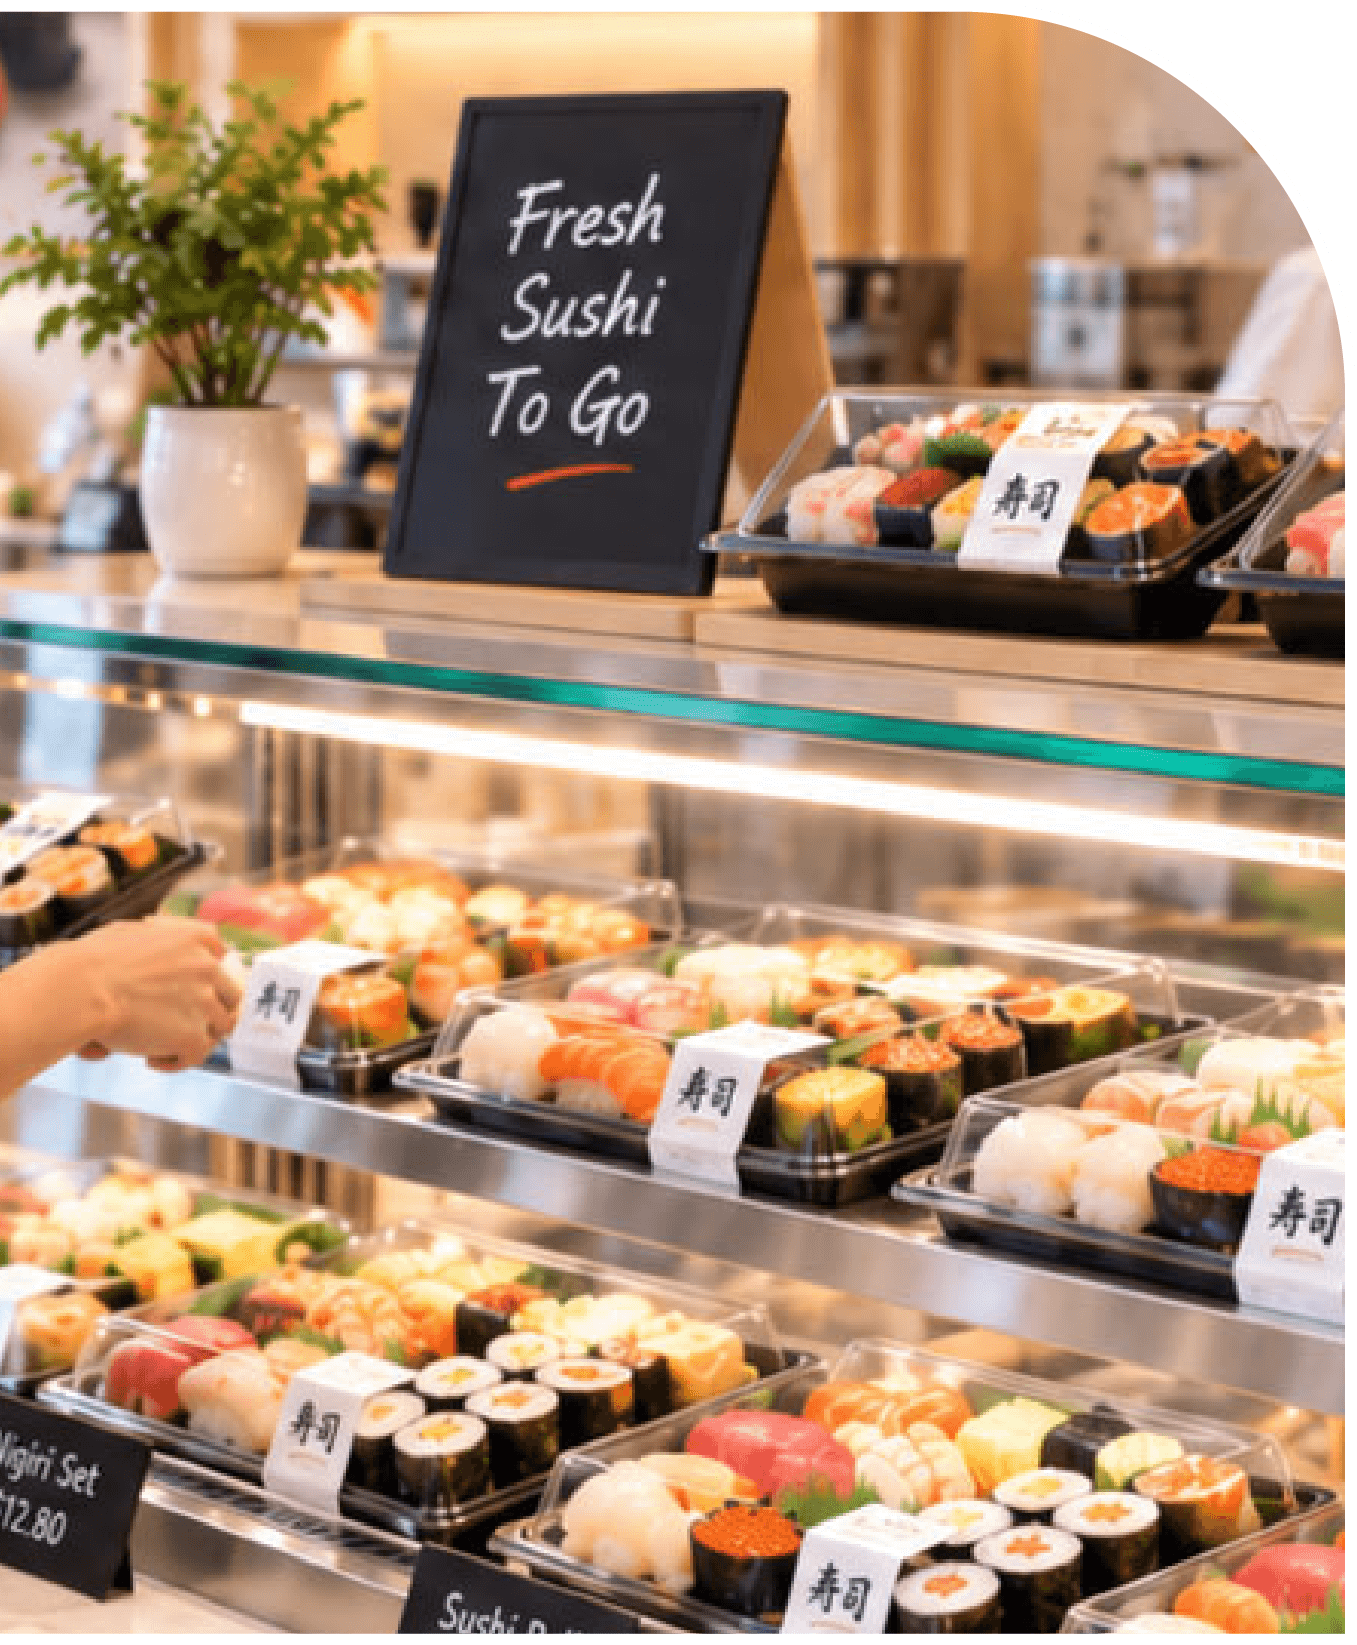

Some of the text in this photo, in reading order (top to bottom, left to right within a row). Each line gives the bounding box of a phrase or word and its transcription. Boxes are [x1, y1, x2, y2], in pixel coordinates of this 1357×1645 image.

[507, 171, 666, 255] Fresh
[500, 269, 666, 343] Sushi
[488, 364, 650, 447] To Go
[992, 472, 1060, 523] 寿司
[675, 1065, 739, 1119] 寿司
[1268, 1183, 1343, 1248] 寿司
[56, 1451, 102, 1499] Set
[805, 1558, 874, 1625] 寿司
